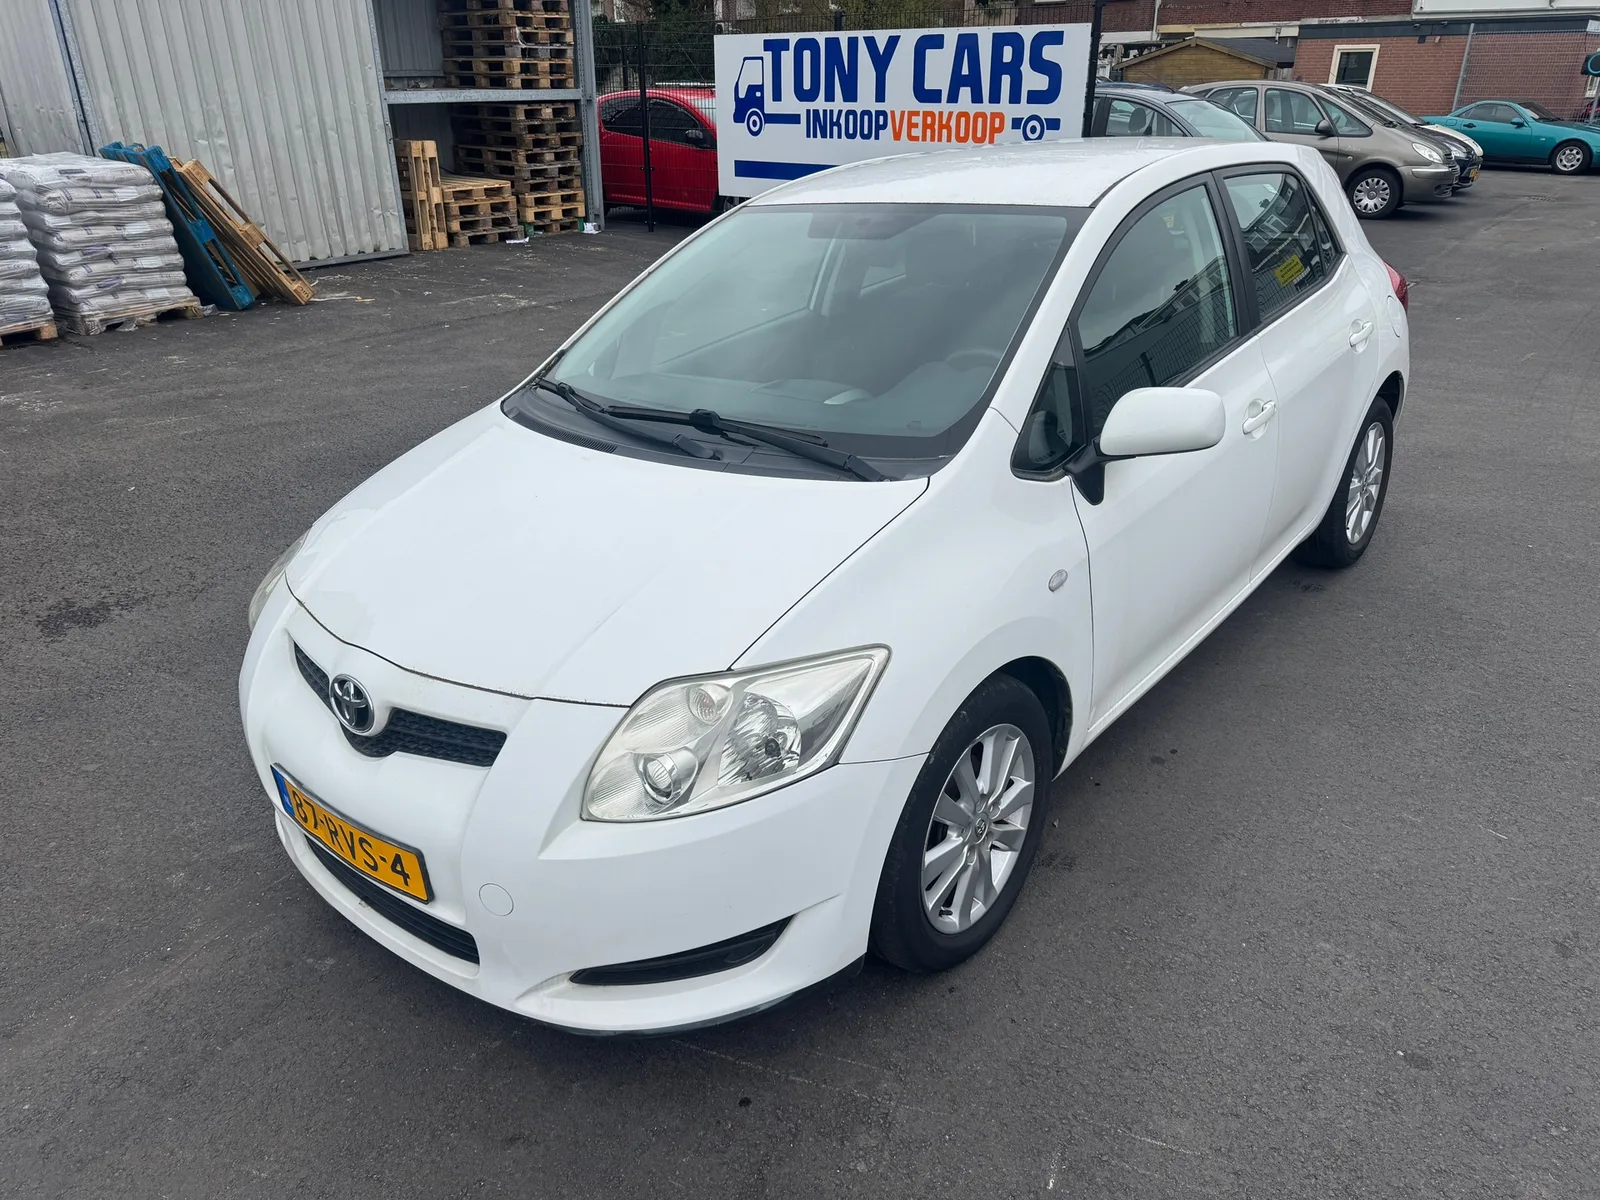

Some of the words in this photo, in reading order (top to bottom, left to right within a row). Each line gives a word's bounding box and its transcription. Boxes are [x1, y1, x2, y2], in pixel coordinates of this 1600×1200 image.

[763, 35, 901, 103] TONY
[913, 31, 1064, 105] CARS
[293, 790, 410, 887] 87-RVS-4
